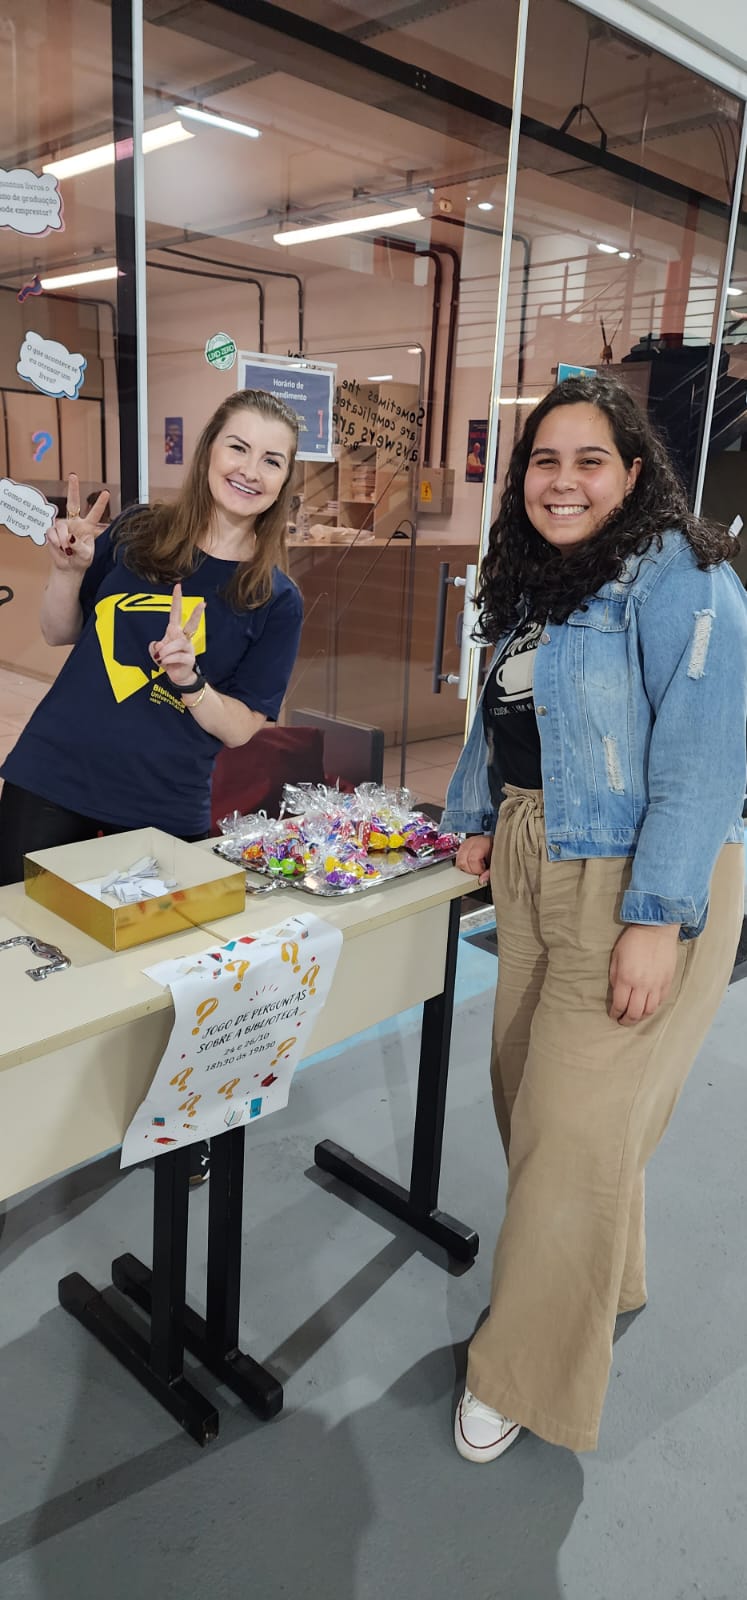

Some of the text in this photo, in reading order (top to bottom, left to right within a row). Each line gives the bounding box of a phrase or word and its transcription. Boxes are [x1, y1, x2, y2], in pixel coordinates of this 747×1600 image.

[13, 193, 20, 201] de
[33, 348, 43, 358] que
[273, 378, 304, 390] Horário de
[271, 391, 307, 401] tendimento
[3, 489, 22, 502] Como
[31, 505, 49, 517] posso
[7, 514, 30, 530] livros?
[27, 515, 45, 528] meus
[202, 989, 307, 1039] JOGO DE PERGUNTAS
[196, 1006, 299, 1054] SOBRE A BIBLIOTECA
[205, 1057, 235, 1072] 18h30
[249, 1041, 276, 1056] 19h30
